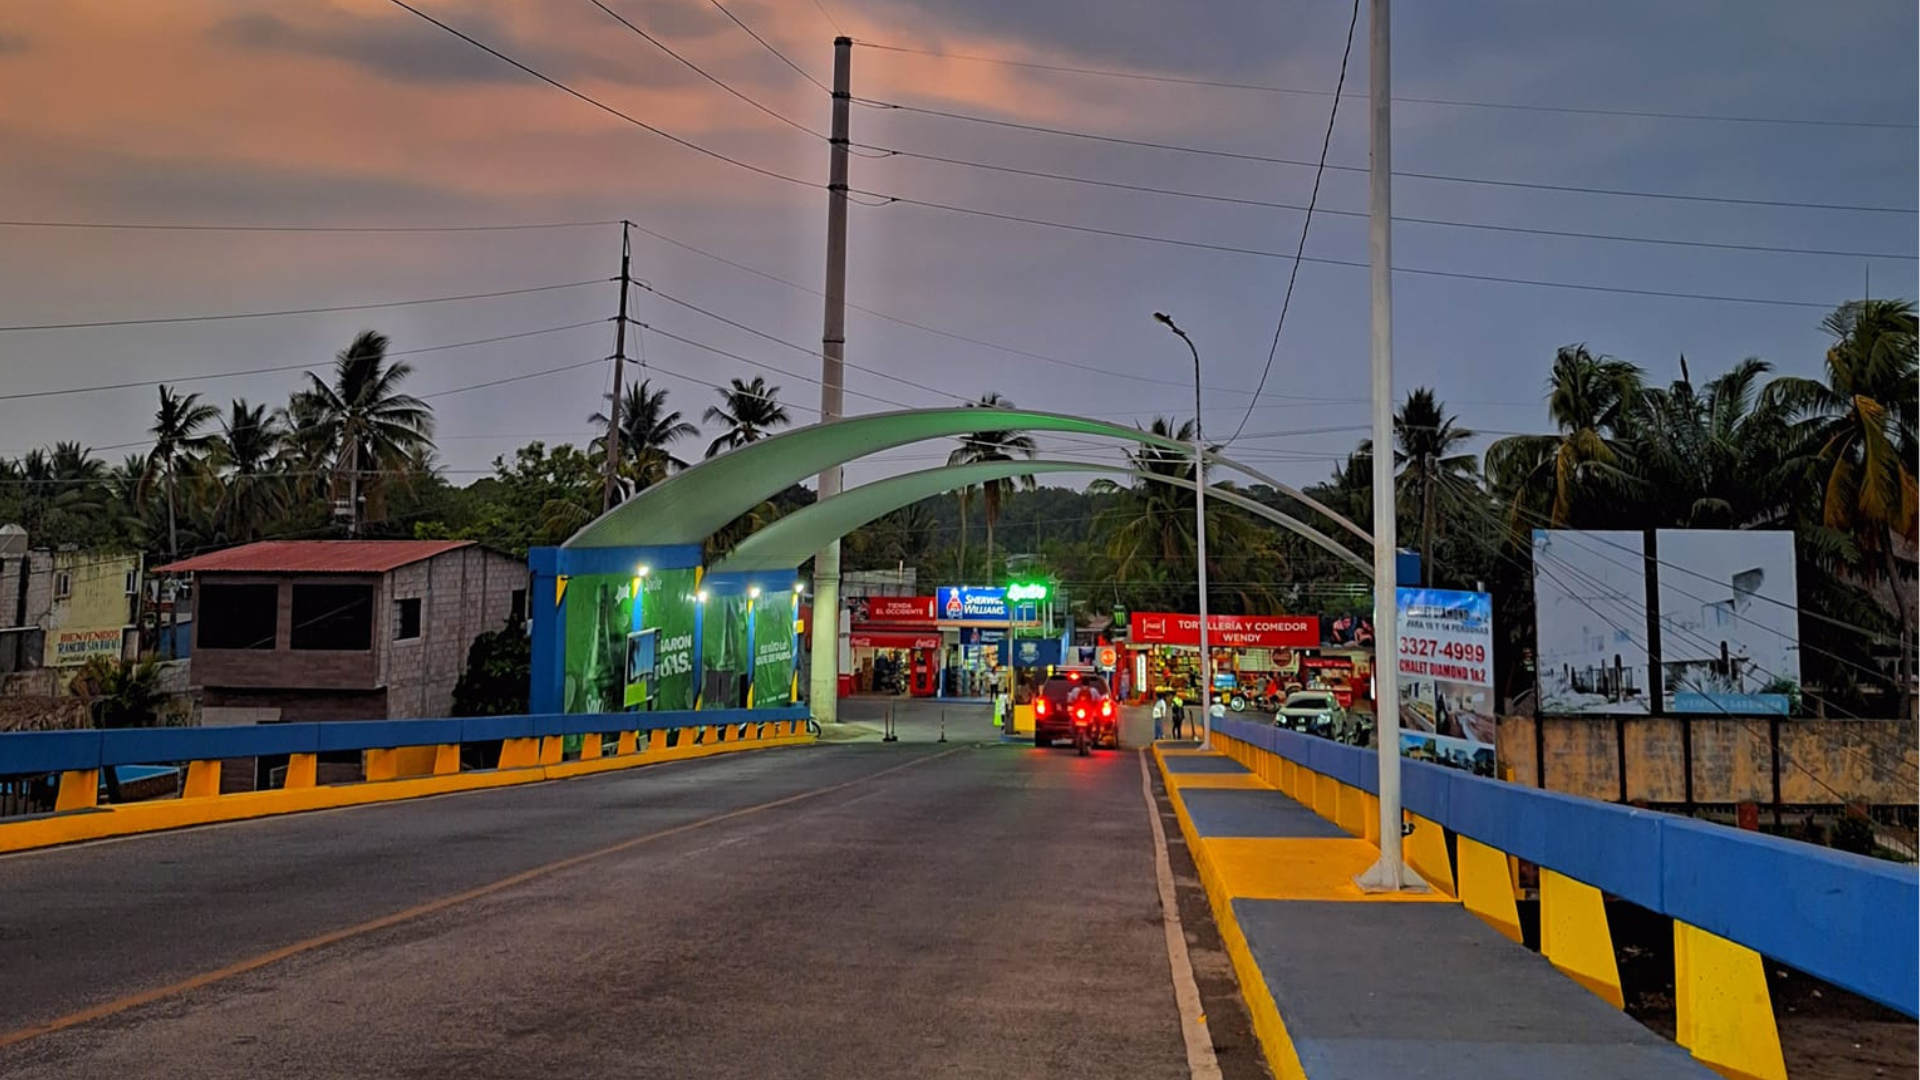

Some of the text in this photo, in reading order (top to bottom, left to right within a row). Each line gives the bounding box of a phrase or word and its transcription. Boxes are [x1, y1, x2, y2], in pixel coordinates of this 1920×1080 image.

[1245, 622, 1253, 631] Y
[1254, 622, 1308, 632] COMEDOR
[60, 630, 121, 643] BIENVENIDOS
[1222, 633, 1262, 642] WENDY
[1399, 636, 1486, 664] 3327-4999
[1399, 659, 1428, 675] CHALET
[1429, 662, 1468, 680] DIAMOND
